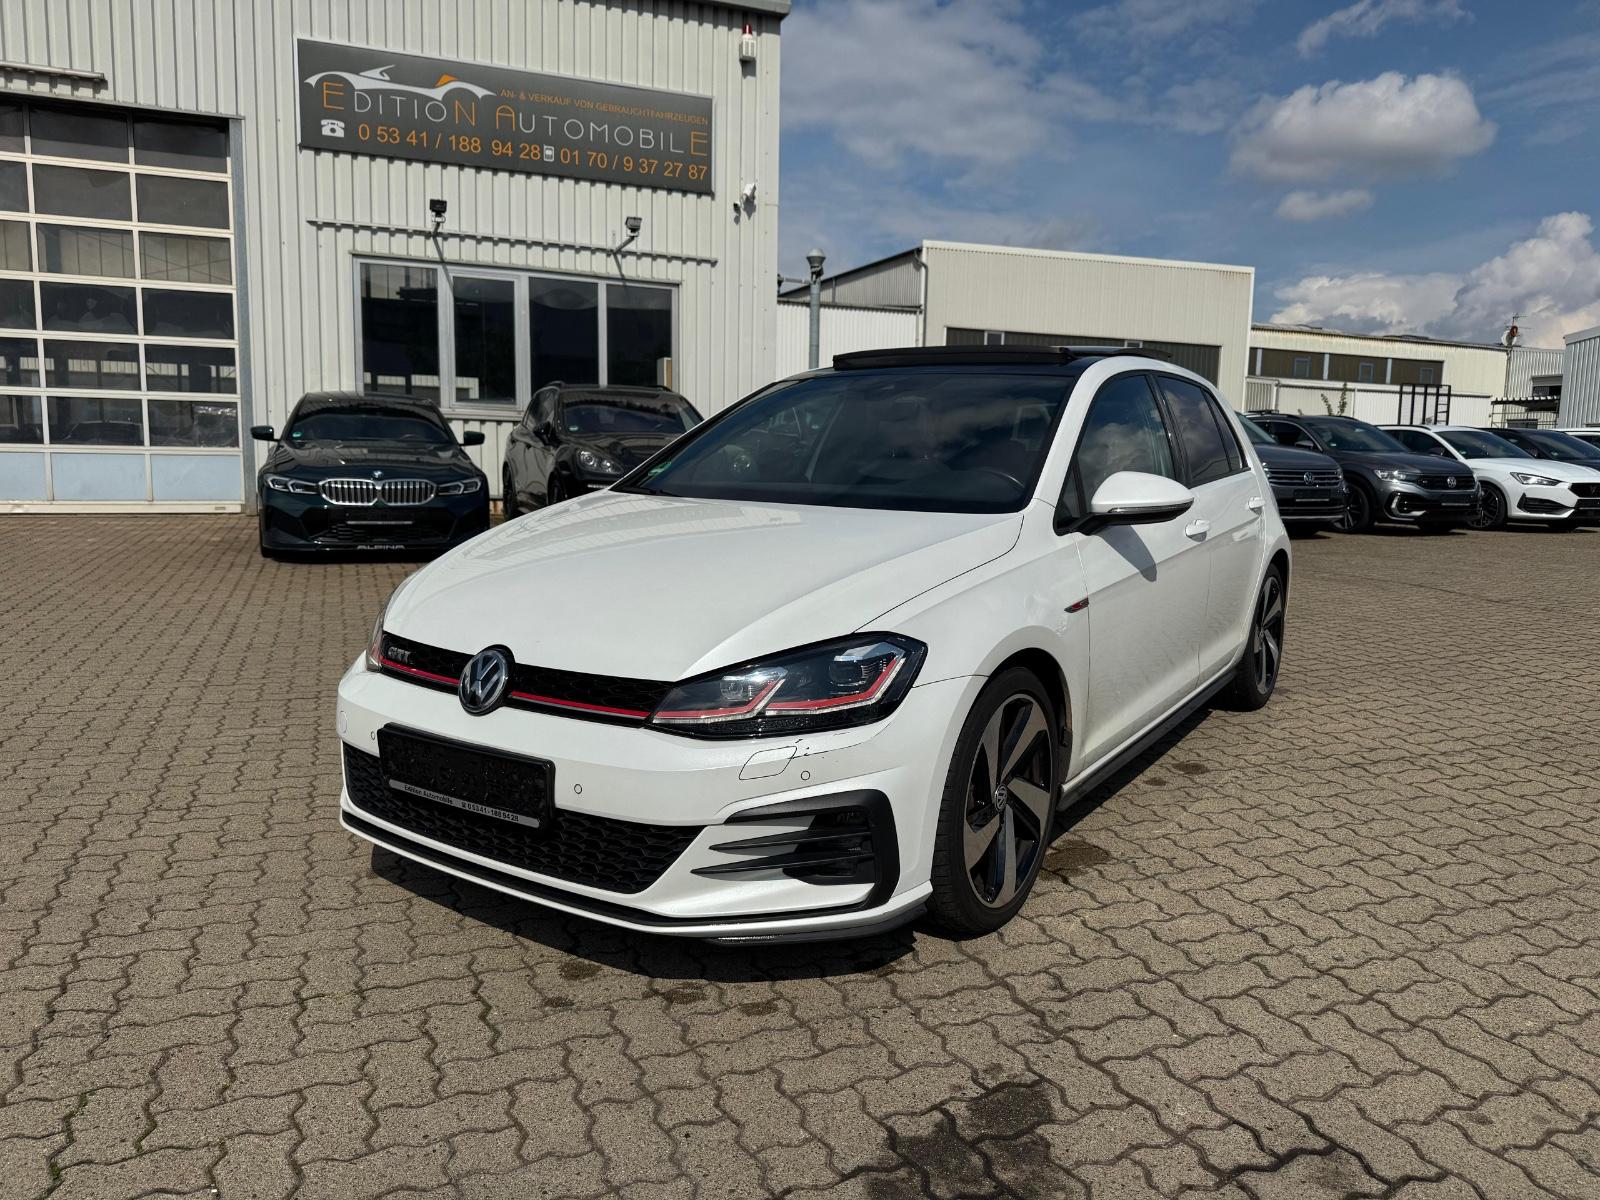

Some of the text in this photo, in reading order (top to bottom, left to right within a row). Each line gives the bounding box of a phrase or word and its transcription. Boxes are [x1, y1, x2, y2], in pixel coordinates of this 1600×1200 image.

[323, 81, 708, 157] EDITION AUTOMOBILE
[500, 88, 517, 98] AN-
[528, 93, 571, 106] VERKAUF
[575, 99, 593, 110] VON
[596, 102, 709, 126] GEBRAUCHTFAHRZEUGEN
[358, 123, 370, 141] 0
[377, 126, 400, 144] 53
[406, 130, 428, 148] 41
[449, 135, 481, 153] 188
[491, 139, 513, 157] 94
[519, 143, 541, 161] 28
[560, 148, 580, 165] 01
[586, 151, 608, 169] 70
[623, 156, 634, 172] 9
[639, 158, 659, 175] 37
[663, 161, 684, 178] 27
[688, 164, 708, 181] 87
